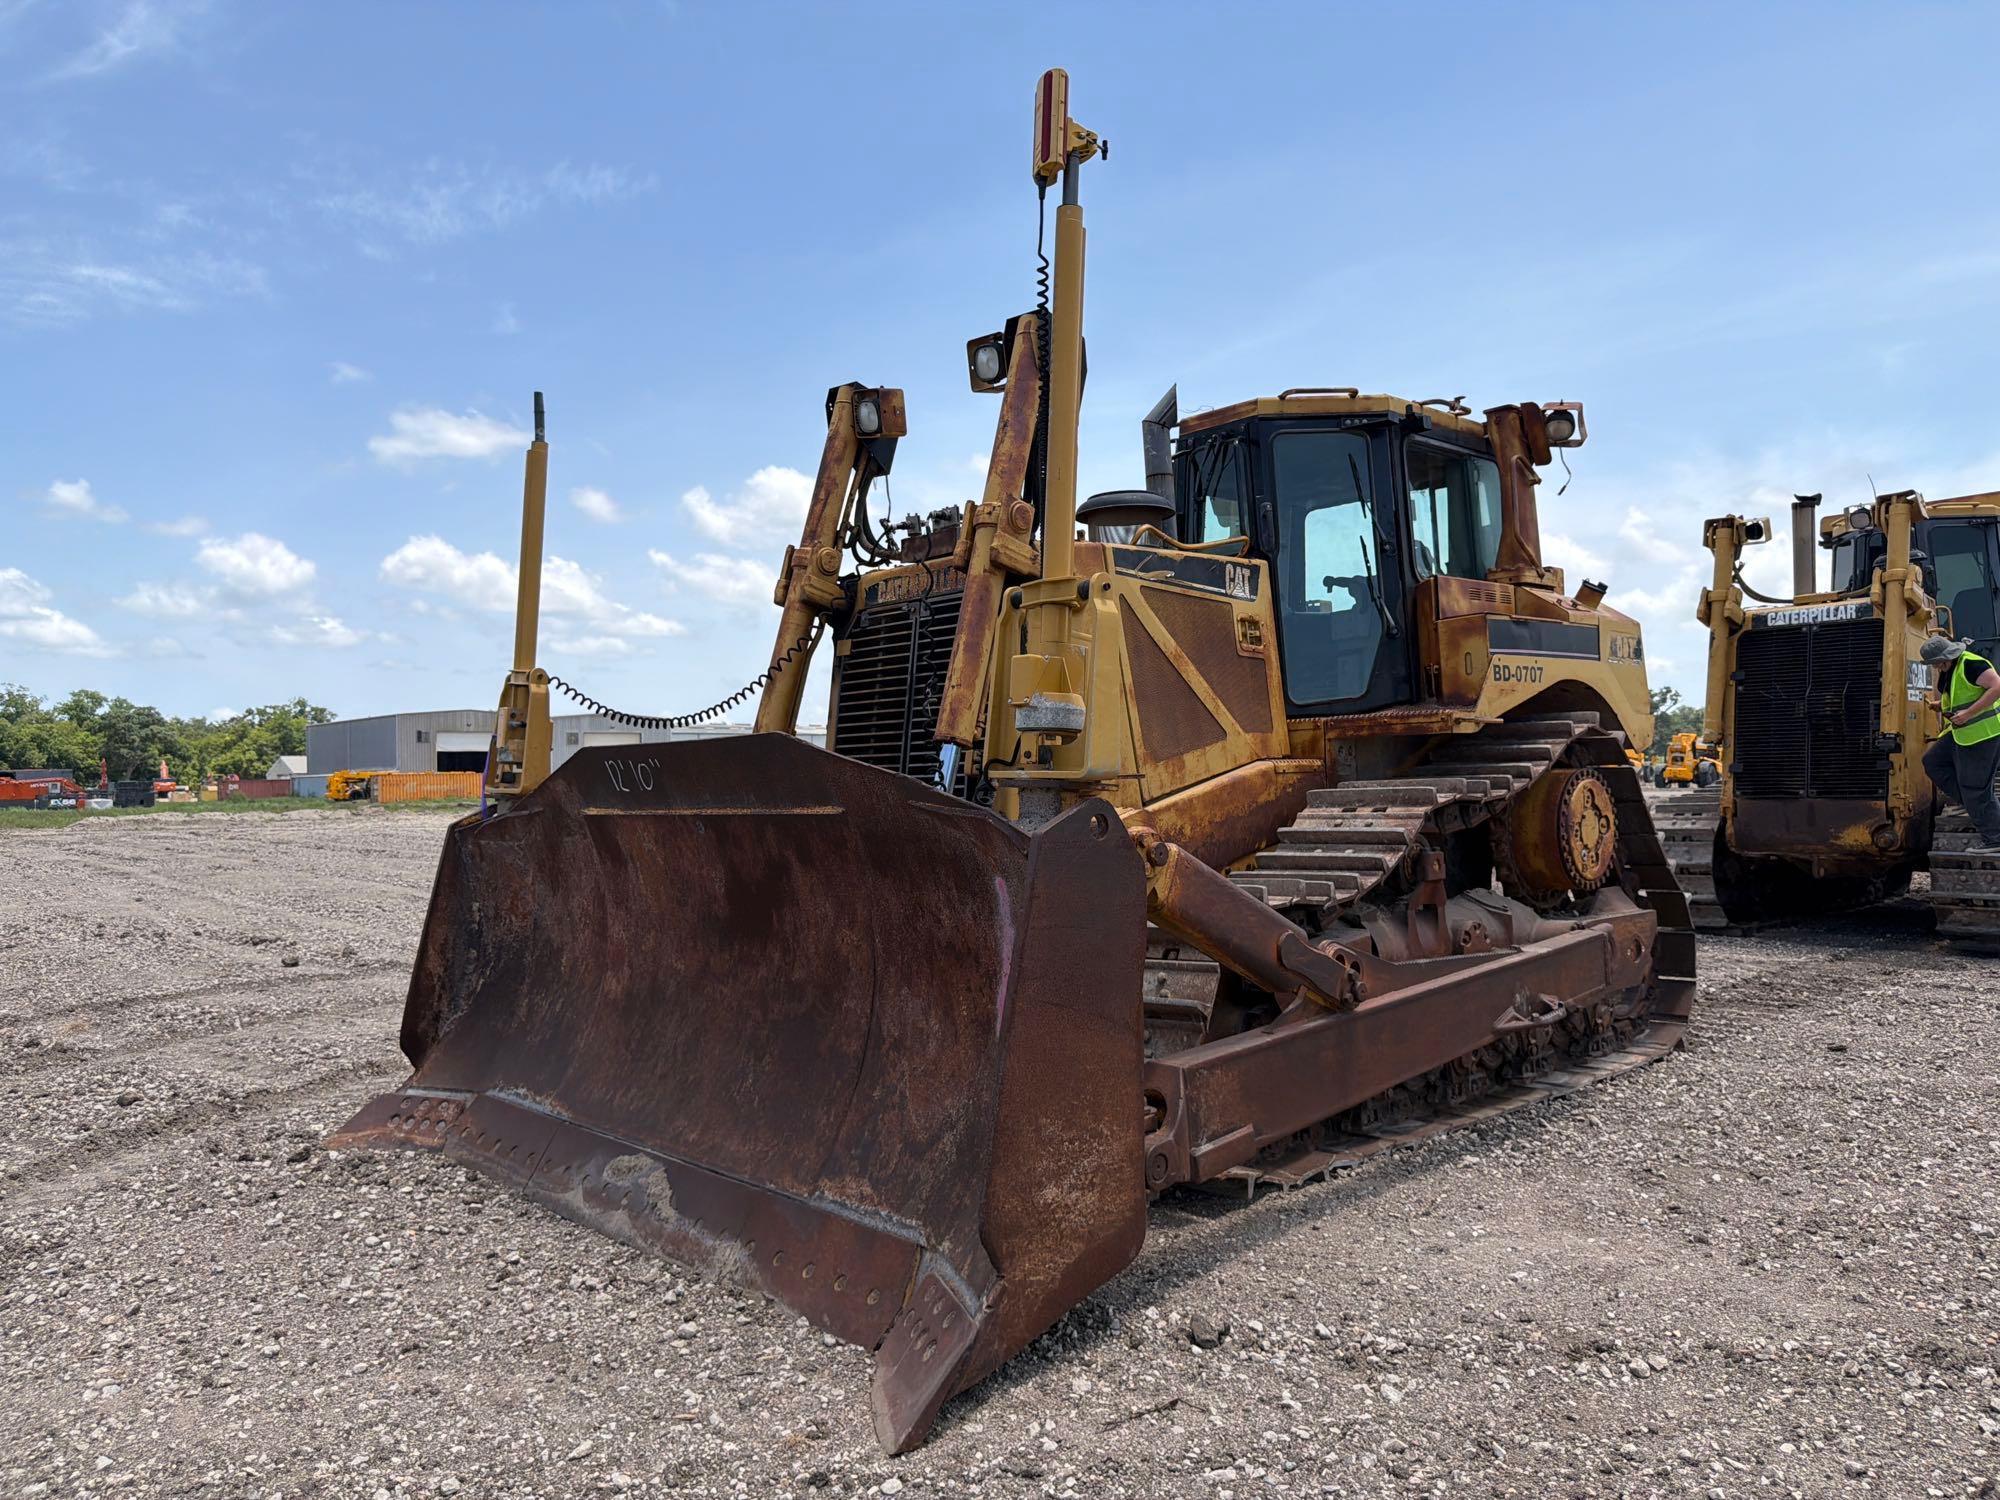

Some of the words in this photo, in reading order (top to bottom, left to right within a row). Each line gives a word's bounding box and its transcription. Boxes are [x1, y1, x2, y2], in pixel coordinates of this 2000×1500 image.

[1225, 563, 1250, 599] CAT
[1767, 604, 1857, 626] CATERPILLAR
[1493, 664, 1543, 683] BD-0707
[1910, 663, 1927, 688] CAT
